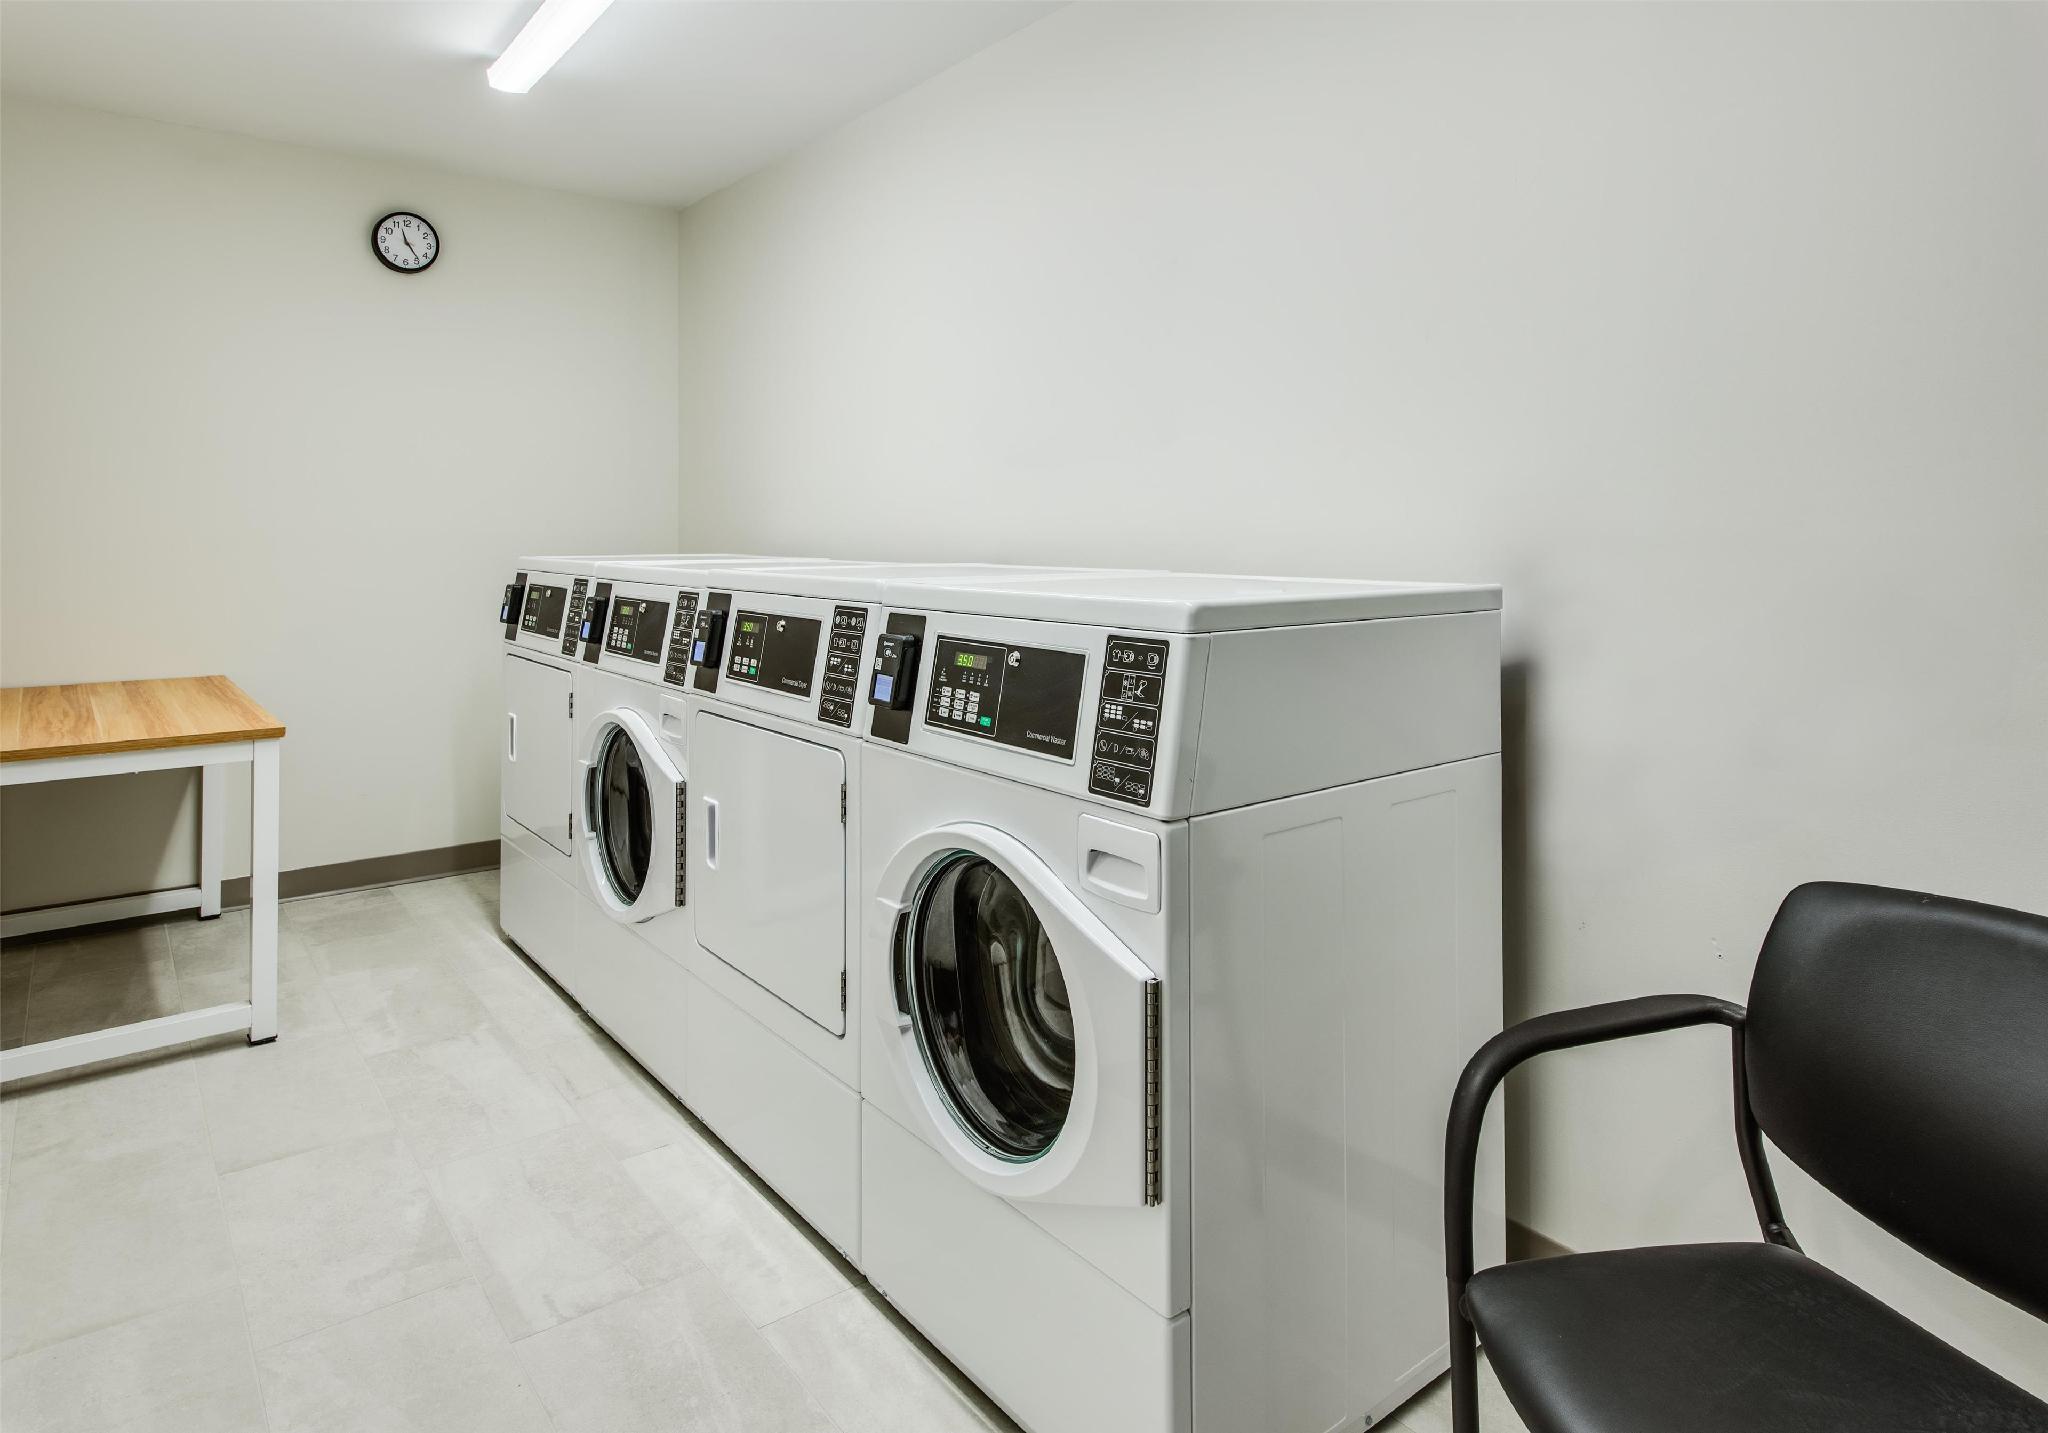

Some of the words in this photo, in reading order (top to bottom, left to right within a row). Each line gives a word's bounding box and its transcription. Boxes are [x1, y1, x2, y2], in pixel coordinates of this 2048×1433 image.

[393, 220, 400, 229] 11
[402, 219, 412, 228] 12
[384, 226, 394, 236] 10
[380, 236, 386, 244] 9
[422, 232, 428, 240] 2
[384, 246, 390, 254] 8
[426, 242, 432, 250] 3
[414, 257, 420, 265] 5
